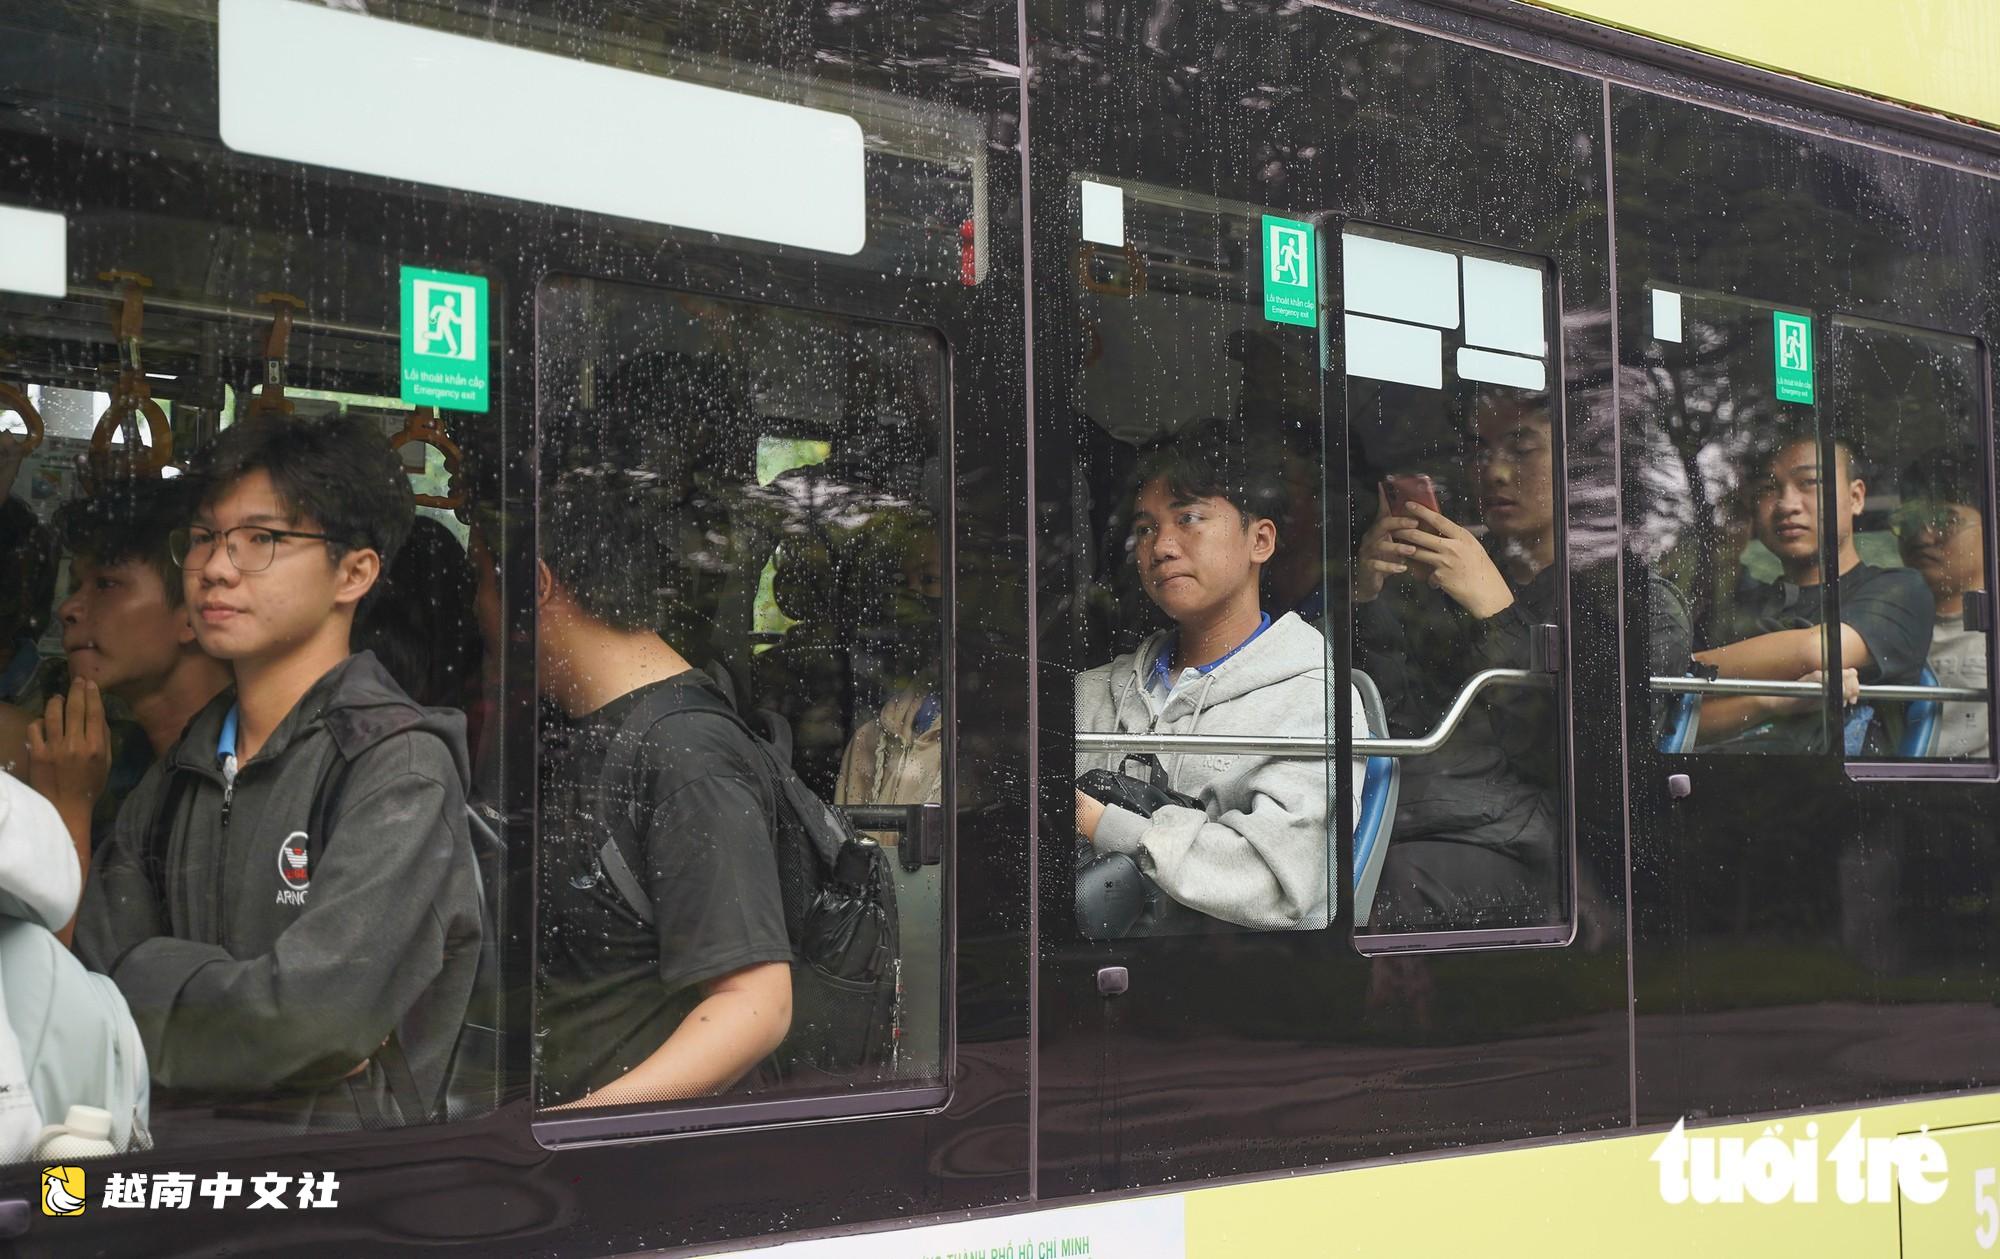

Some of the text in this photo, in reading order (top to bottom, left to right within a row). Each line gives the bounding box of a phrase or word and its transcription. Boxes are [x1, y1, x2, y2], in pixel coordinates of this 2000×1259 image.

[1272, 305, 1299, 319] Emergency
[413, 383, 476, 400] Emergency exit
[1061, 1236, 1089, 1257] MINH
